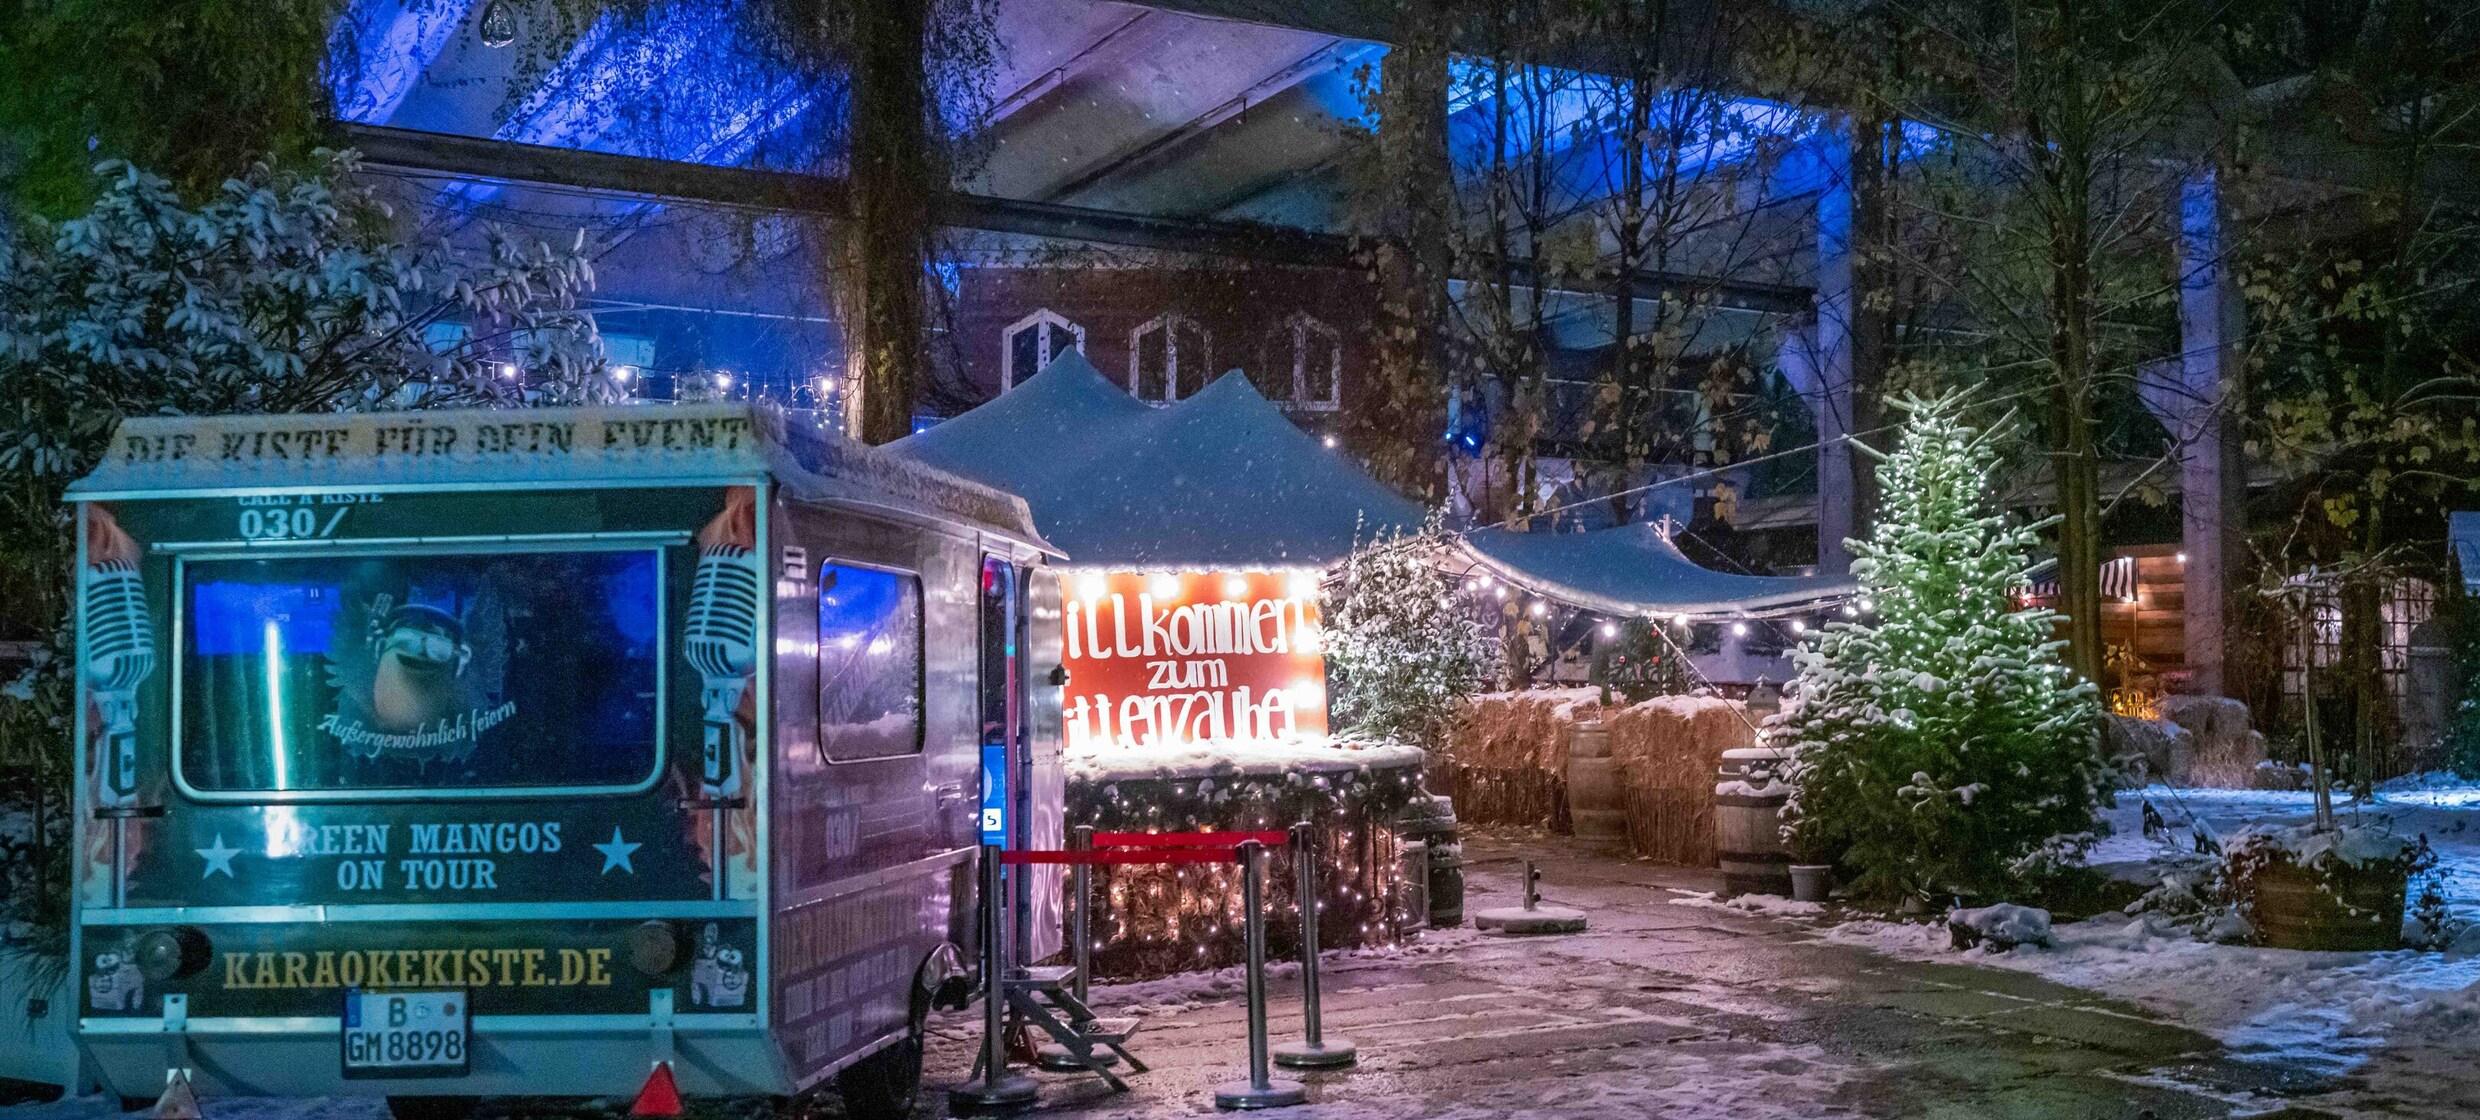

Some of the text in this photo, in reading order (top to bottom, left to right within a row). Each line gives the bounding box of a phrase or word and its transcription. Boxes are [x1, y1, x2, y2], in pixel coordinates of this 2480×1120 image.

[221, 429, 350, 462] KISTE
[375, 418, 458, 456] FÜR
[602, 417, 750, 452] EVENT
[239, 506, 350, 539] 030/
[1065, 592, 1303, 659] illkommen
[1146, 658, 1229, 690] zum
[316, 700, 518, 759] Außergewöhnlich feiern
[409, 822, 562, 854] MANGOS
[337, 859, 498, 891] ON TOUR
[222, 948, 612, 989] KARAOKEKISTE.DE
[388, 997, 407, 1028] B
[348, 1030, 462, 1062] GM 8898
